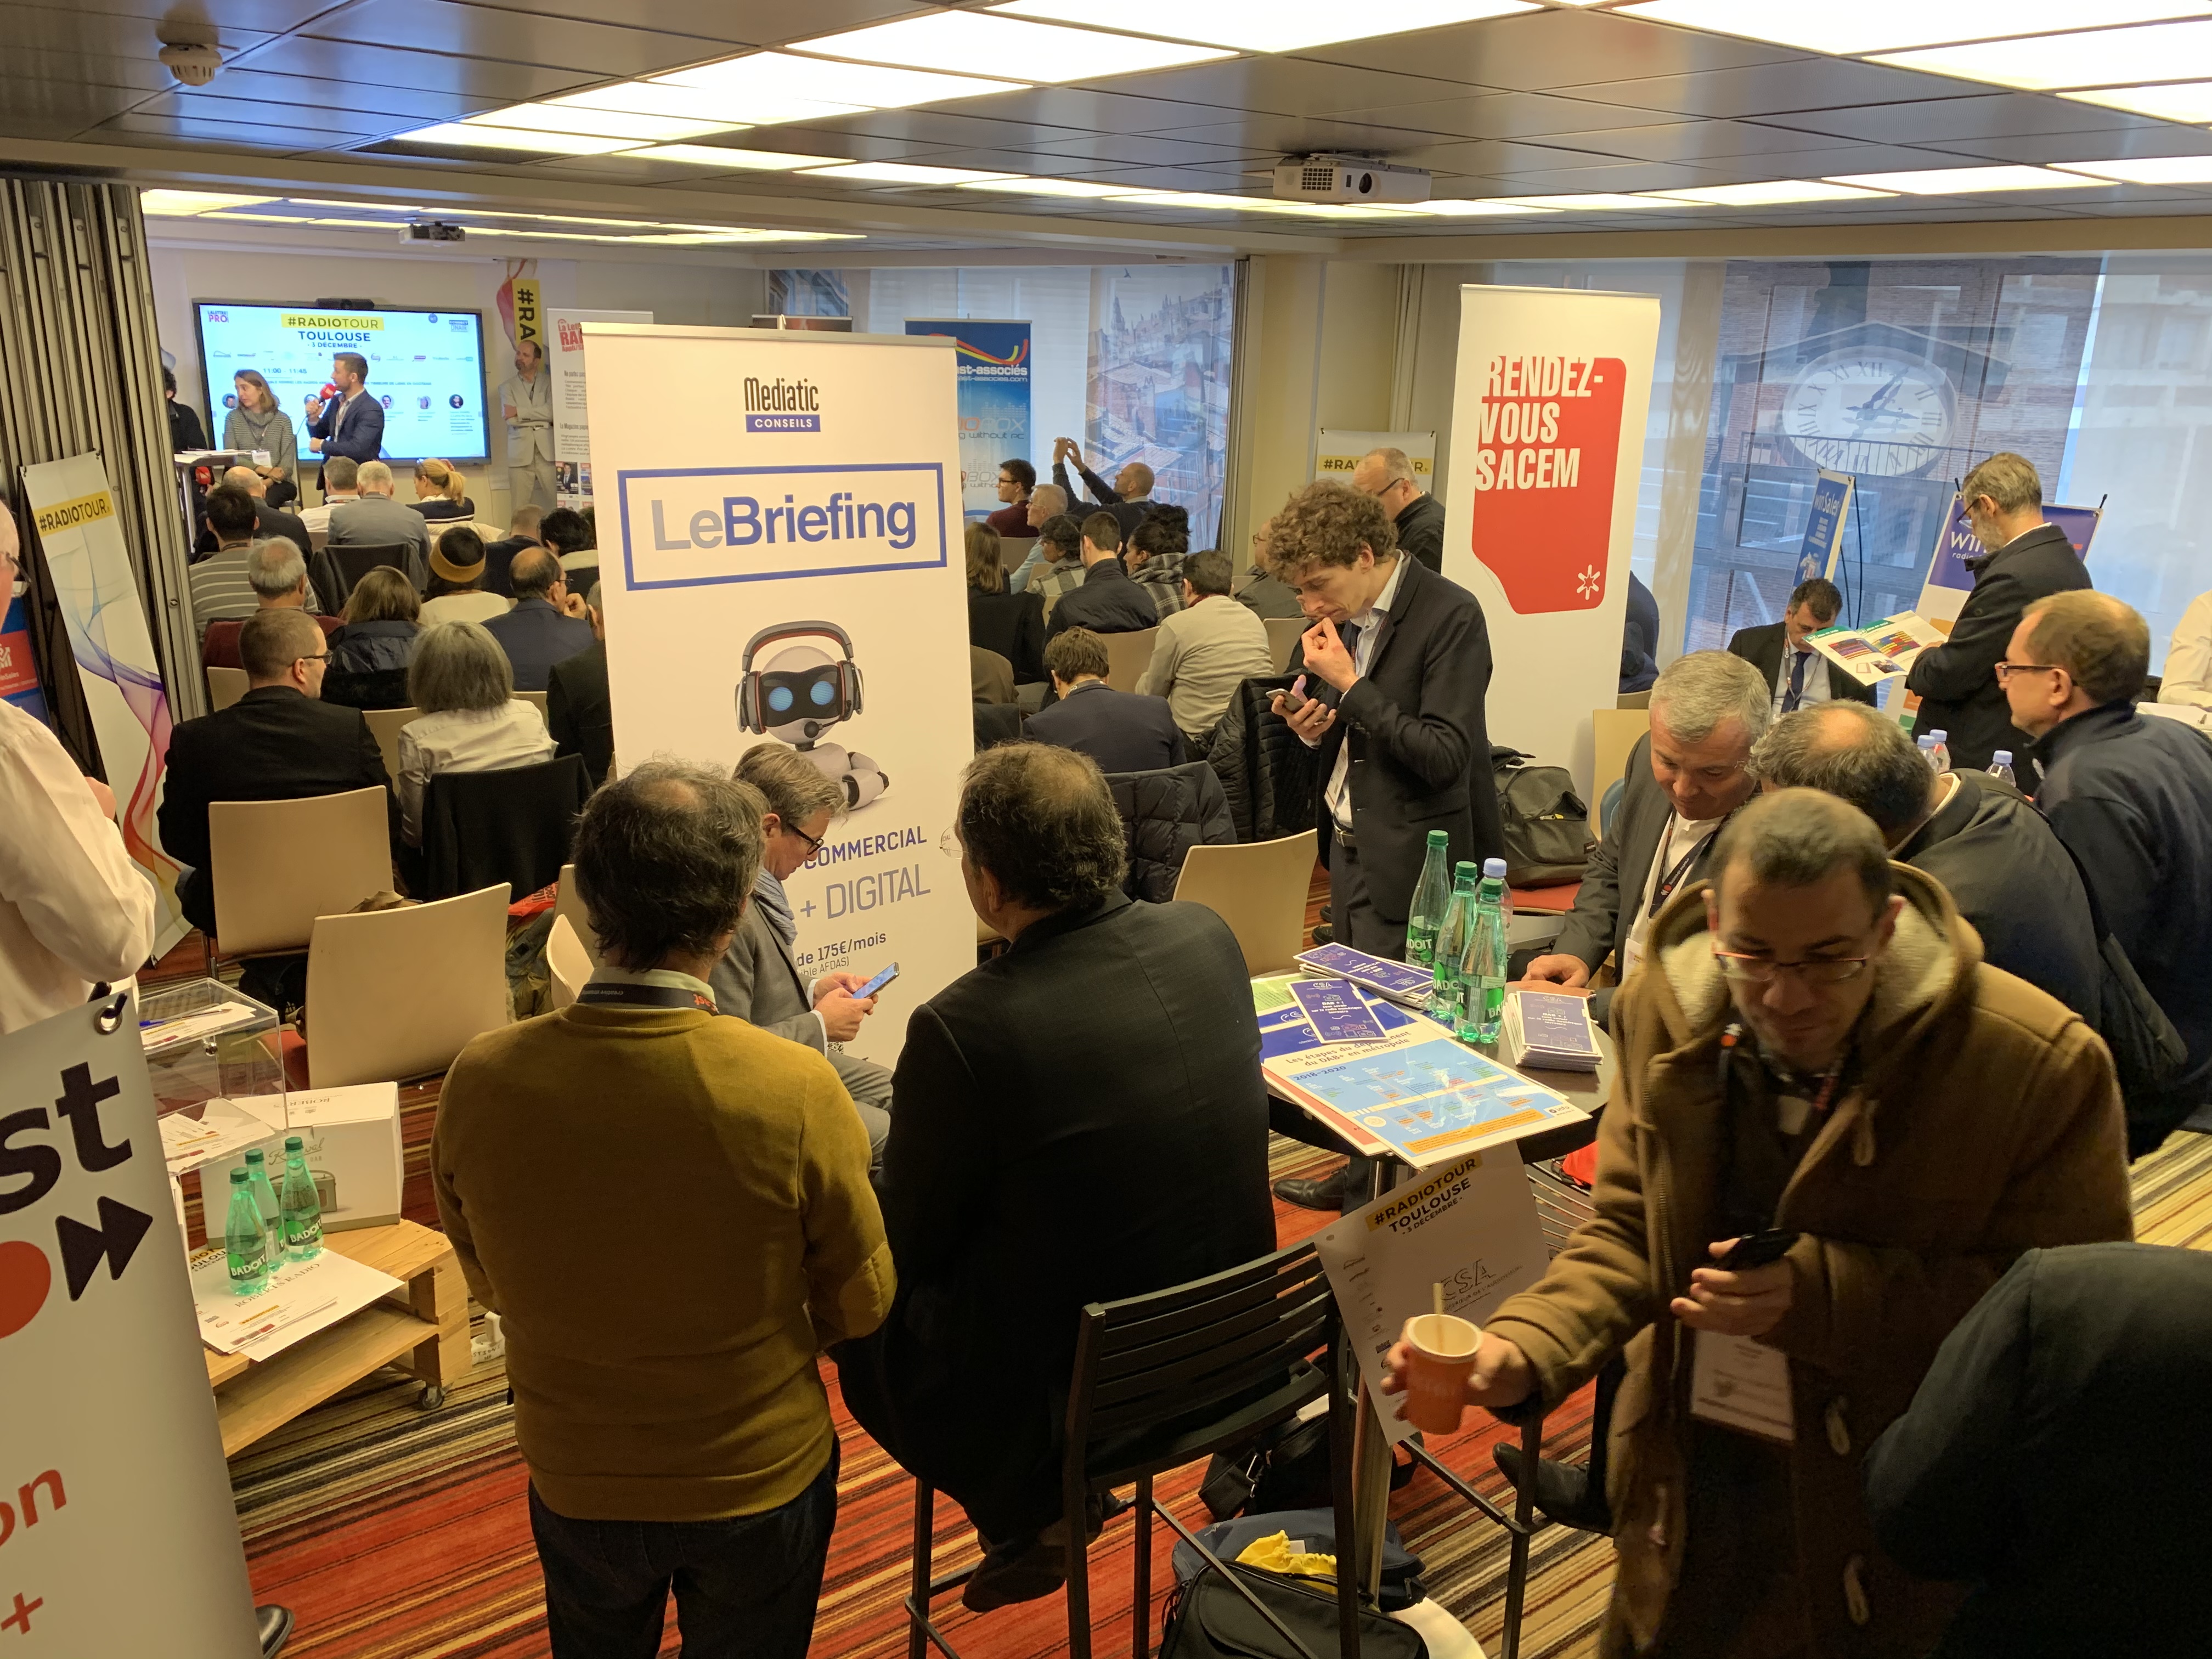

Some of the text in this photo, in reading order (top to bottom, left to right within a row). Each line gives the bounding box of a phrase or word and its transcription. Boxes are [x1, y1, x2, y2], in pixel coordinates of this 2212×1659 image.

[287, 317, 379, 329] #RADIOTOUR
[298, 331, 371, 342] TOULOUSE
[1489, 356, 1603, 398] RENDEZ-
[744, 377, 819, 412] Mediatic
[754, 417, 812, 428] CONSEILS
[1480, 402, 1560, 444] VOUS
[1476, 448, 1580, 491] SACEM
[39, 498, 107, 532] #RADIOTOUR
[651, 492, 916, 551] LeBriefing
[800, 864, 931, 919] + DIGITAL
[797, 932, 887, 967] de 175€/mois
[820, 956, 850, 973] AFDAS)
[1305, 1049, 1338, 1060] étapes
[1321, 1053, 1344, 1063] DAB+
[1362, 1038, 1410, 1053] métropole
[1293, 1065, 1347, 1081] 2018-2020
[1374, 1158, 1476, 1225] #RADIOTOUR
[1389, 1178, 1471, 1232] TOULOUSE
[289, 1219, 323, 1243] BADOIT
[230, 1254, 267, 1277] BADOIT
[285, 1263, 320, 1282] RADIO
